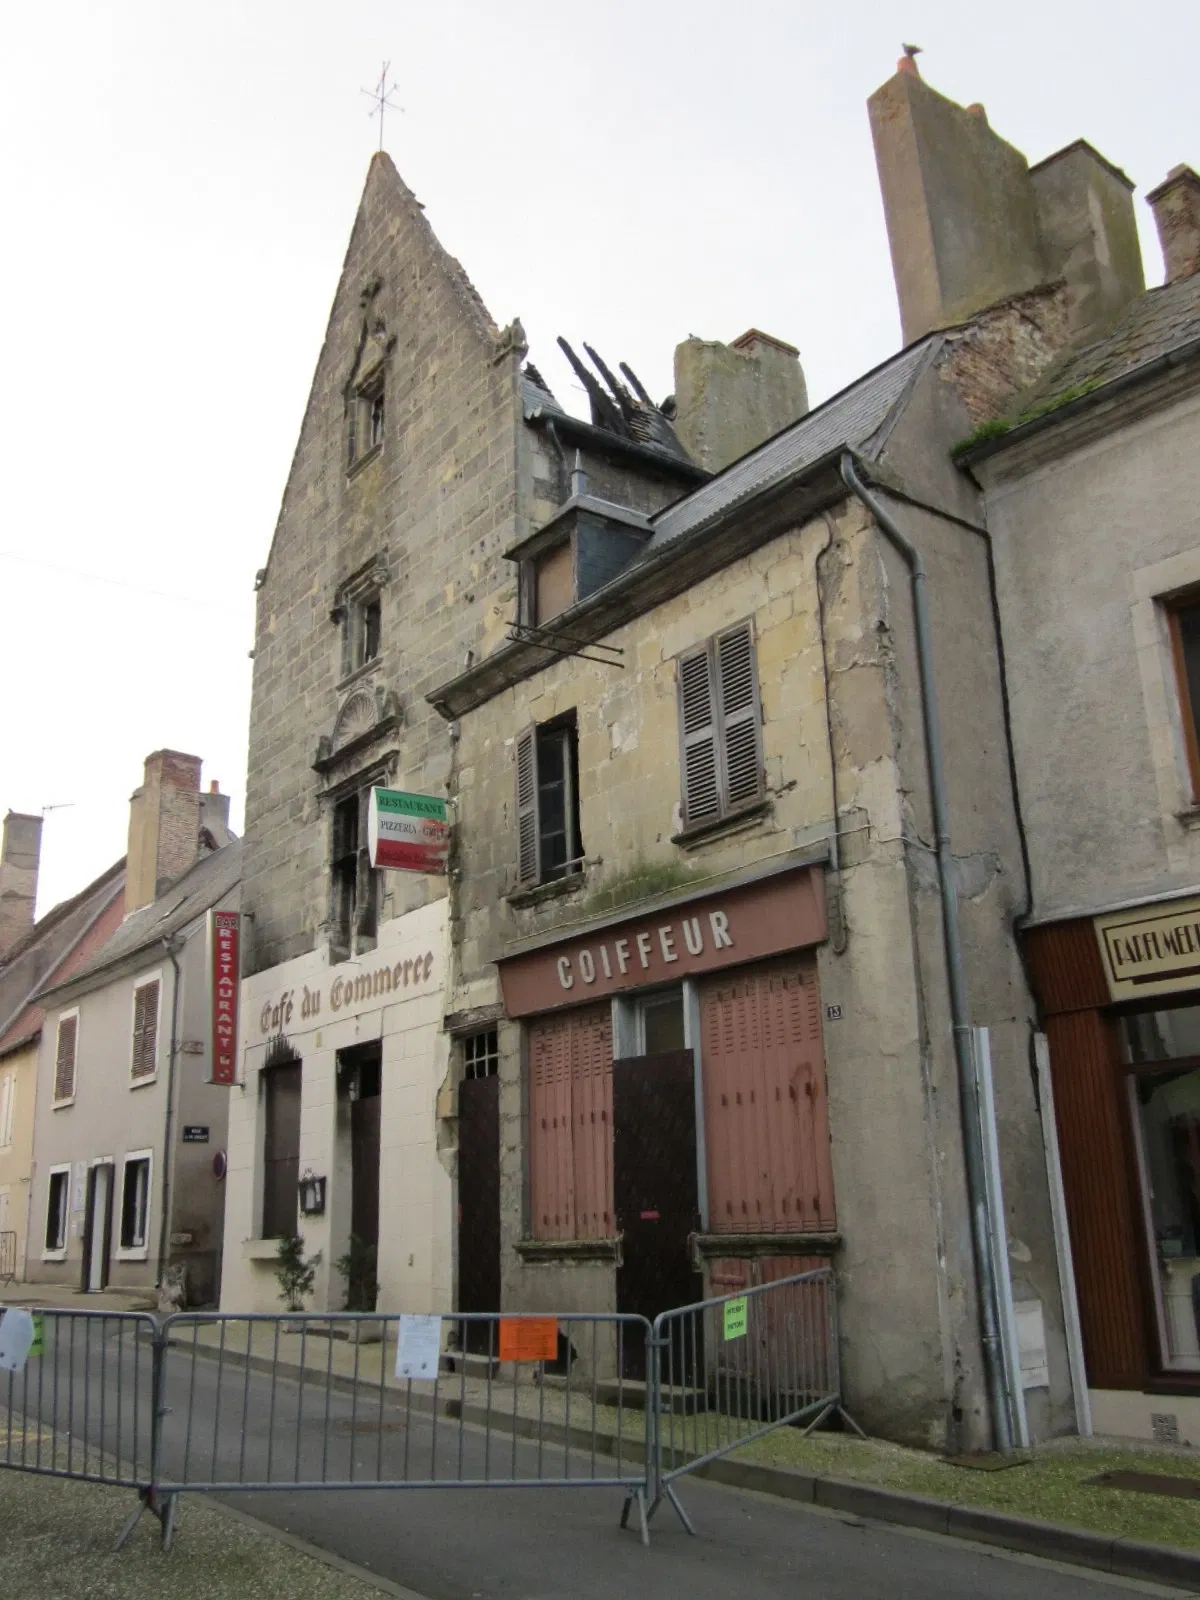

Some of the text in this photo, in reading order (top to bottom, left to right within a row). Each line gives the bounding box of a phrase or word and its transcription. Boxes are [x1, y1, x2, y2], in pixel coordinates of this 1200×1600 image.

[379, 795, 442, 815] RESTAURANT
[381, 820, 417, 835] PIZZERIA
[216, 916, 238, 929] BAR
[557, 911, 734, 989] COIFFEUR
[217, 928, 233, 1047] RESTAURANT
[260, 950, 434, 1034] Café du Commerce
[829, 1006, 840, 1017] 13
